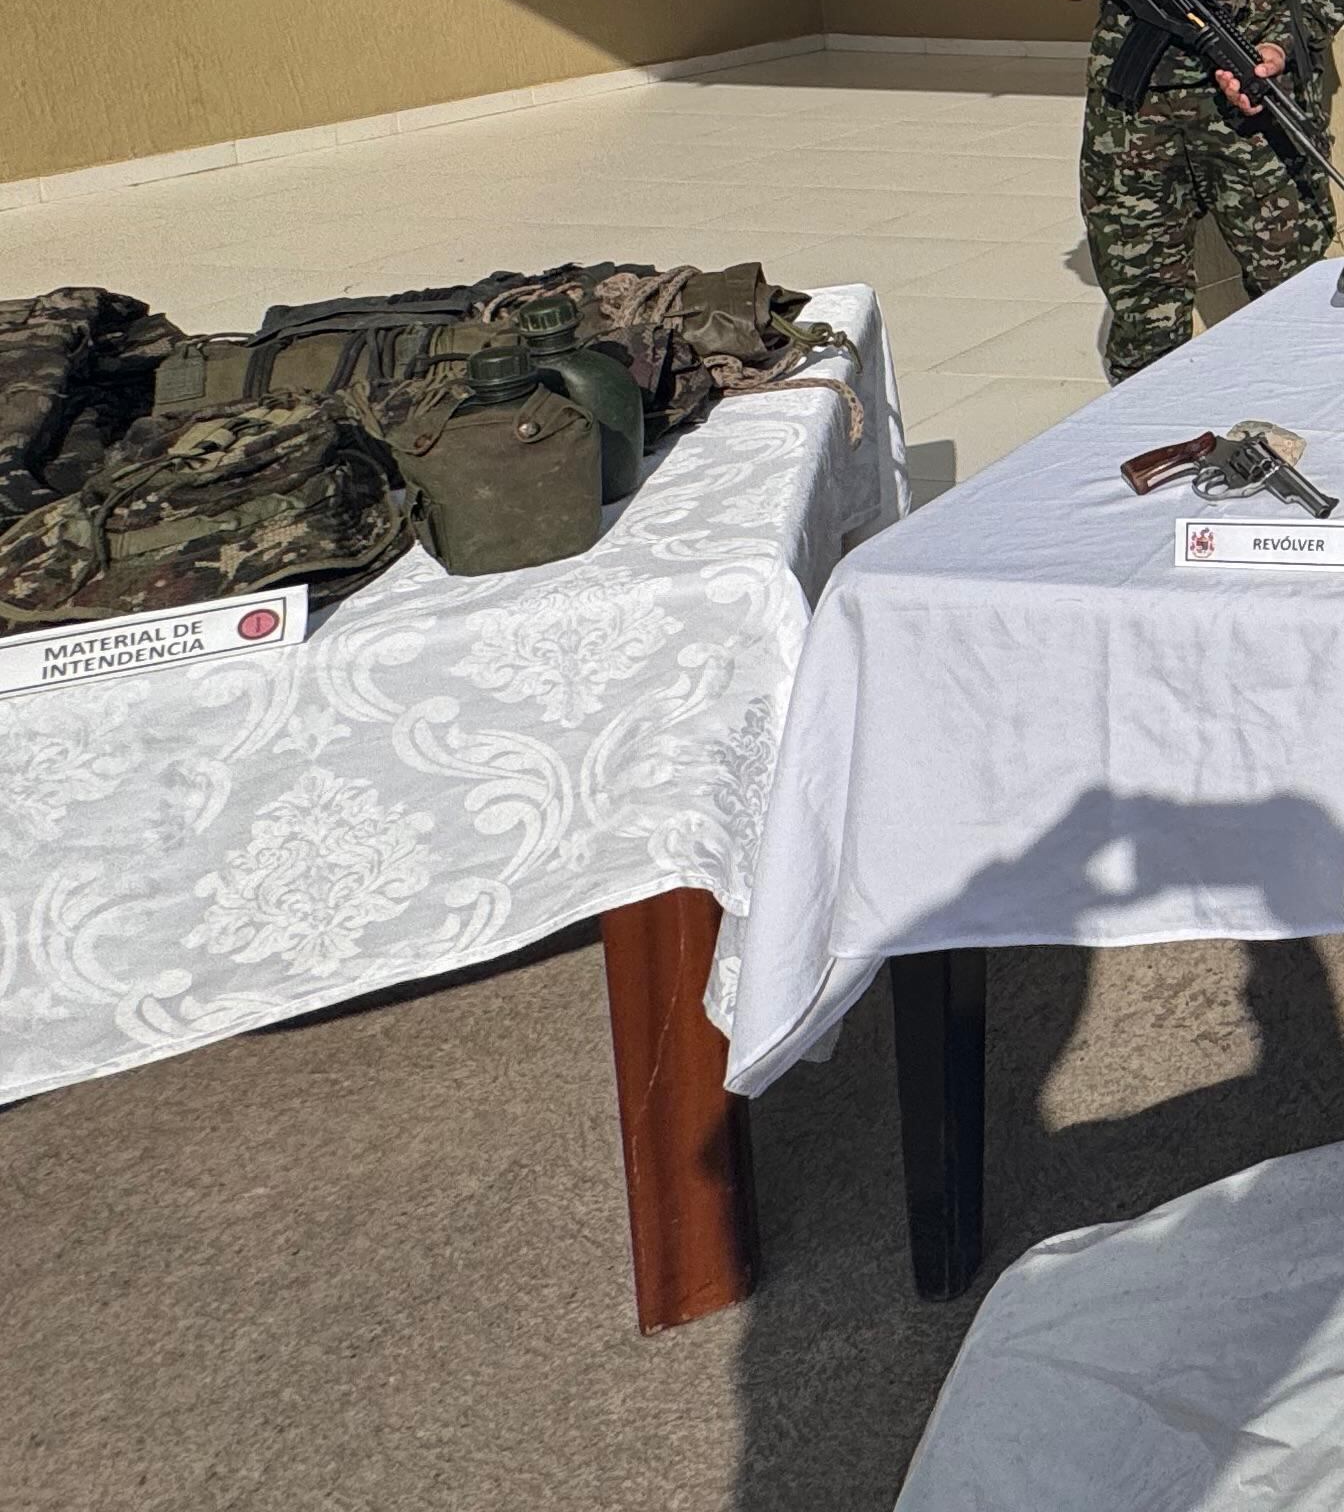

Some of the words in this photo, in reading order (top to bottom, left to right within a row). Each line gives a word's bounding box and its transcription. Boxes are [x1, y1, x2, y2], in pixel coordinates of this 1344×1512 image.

[1252, 535, 1325, 552] REVÓLVER
[41, 638, 205, 680] INTENDENCIA
[44, 628, 167, 661] MATERIAL
[173, 620, 204, 639] DE
